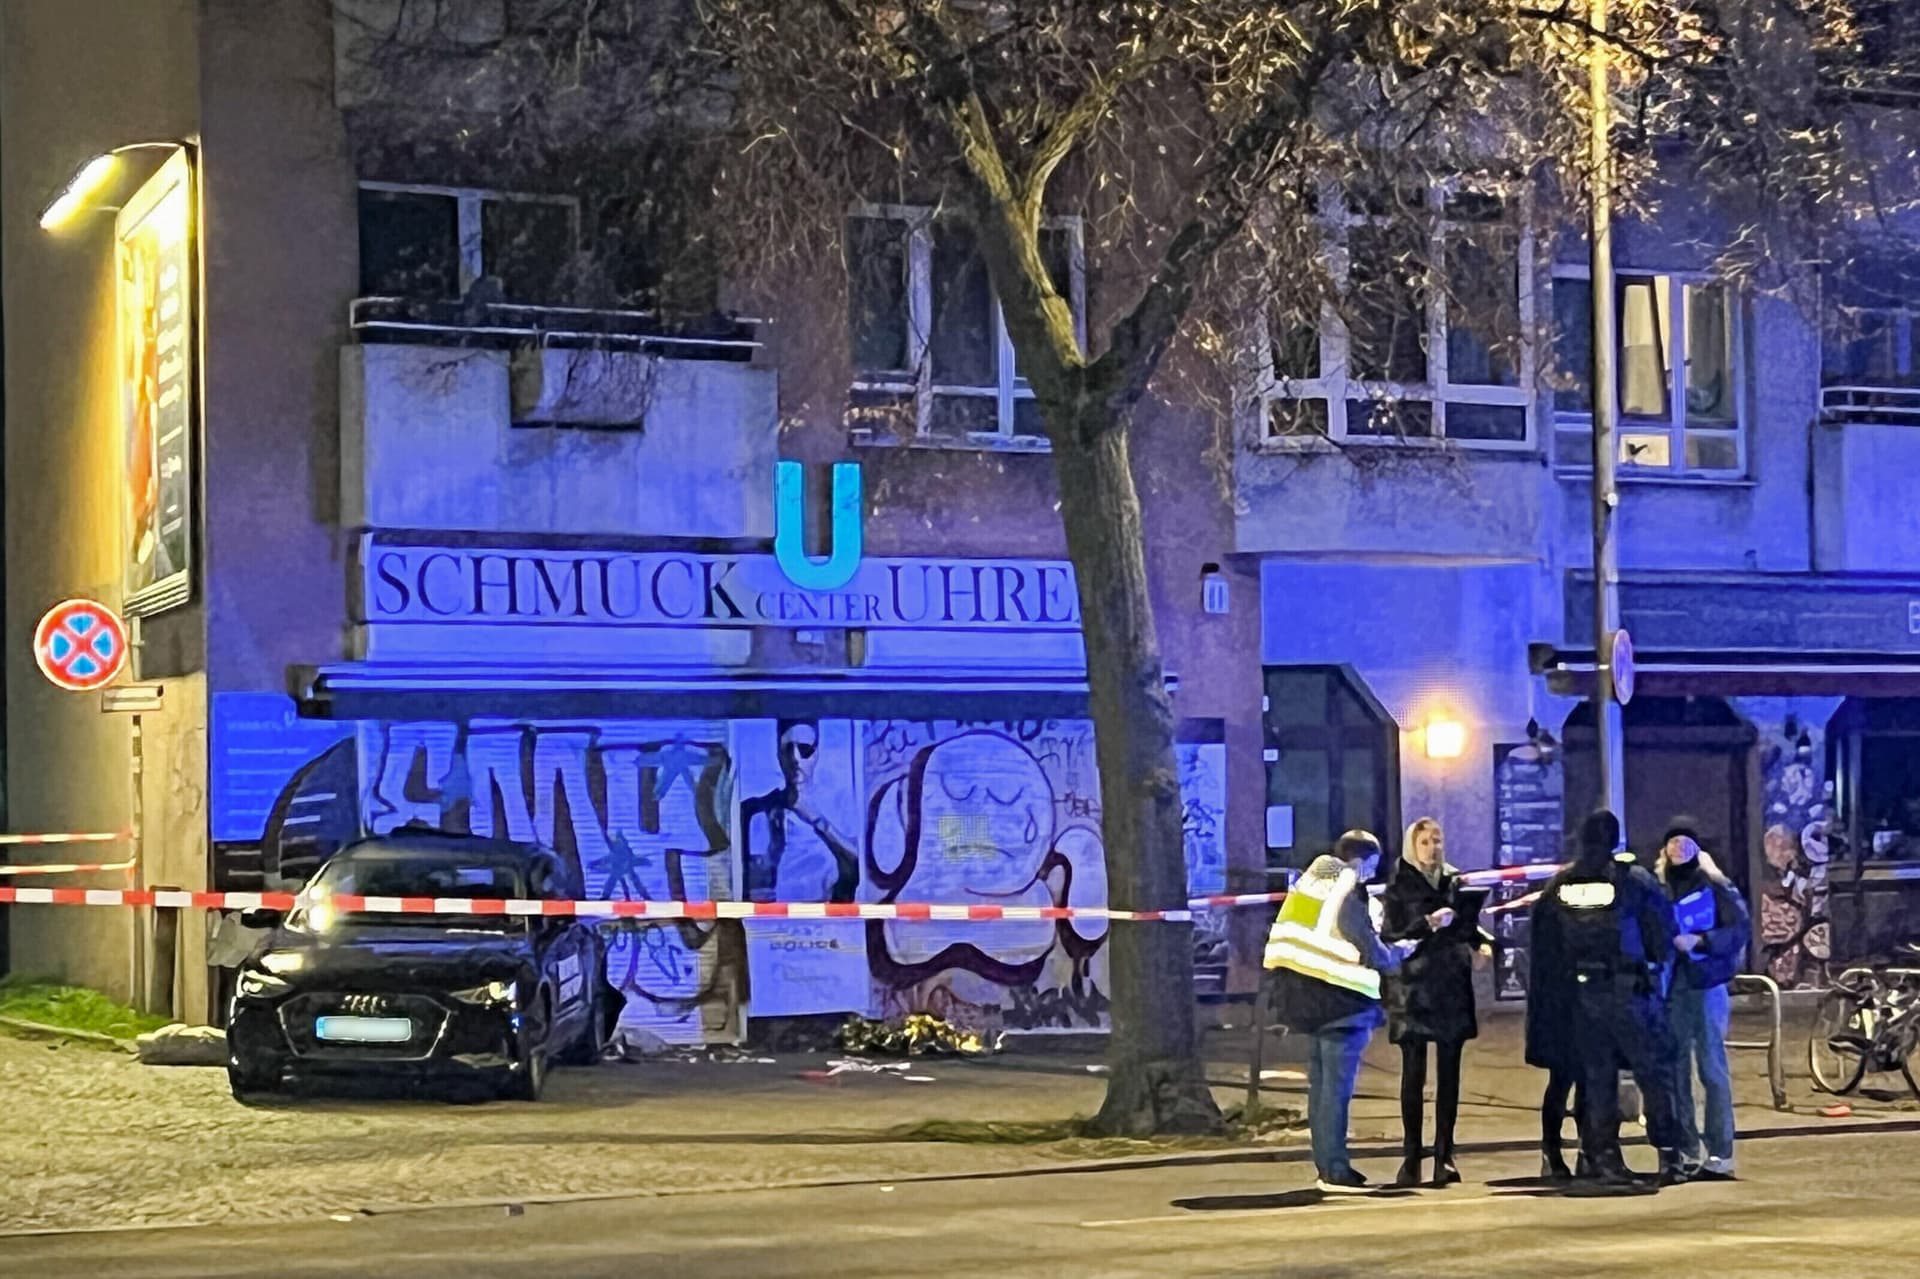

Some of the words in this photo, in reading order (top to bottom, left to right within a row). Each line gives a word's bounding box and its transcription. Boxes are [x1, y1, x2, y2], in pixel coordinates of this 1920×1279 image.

[774, 461, 863, 591] U
[375, 552, 745, 620] SCHMUCK
[755, 592, 883, 622] CENTER
[887, 565, 1081, 623] UHRE
